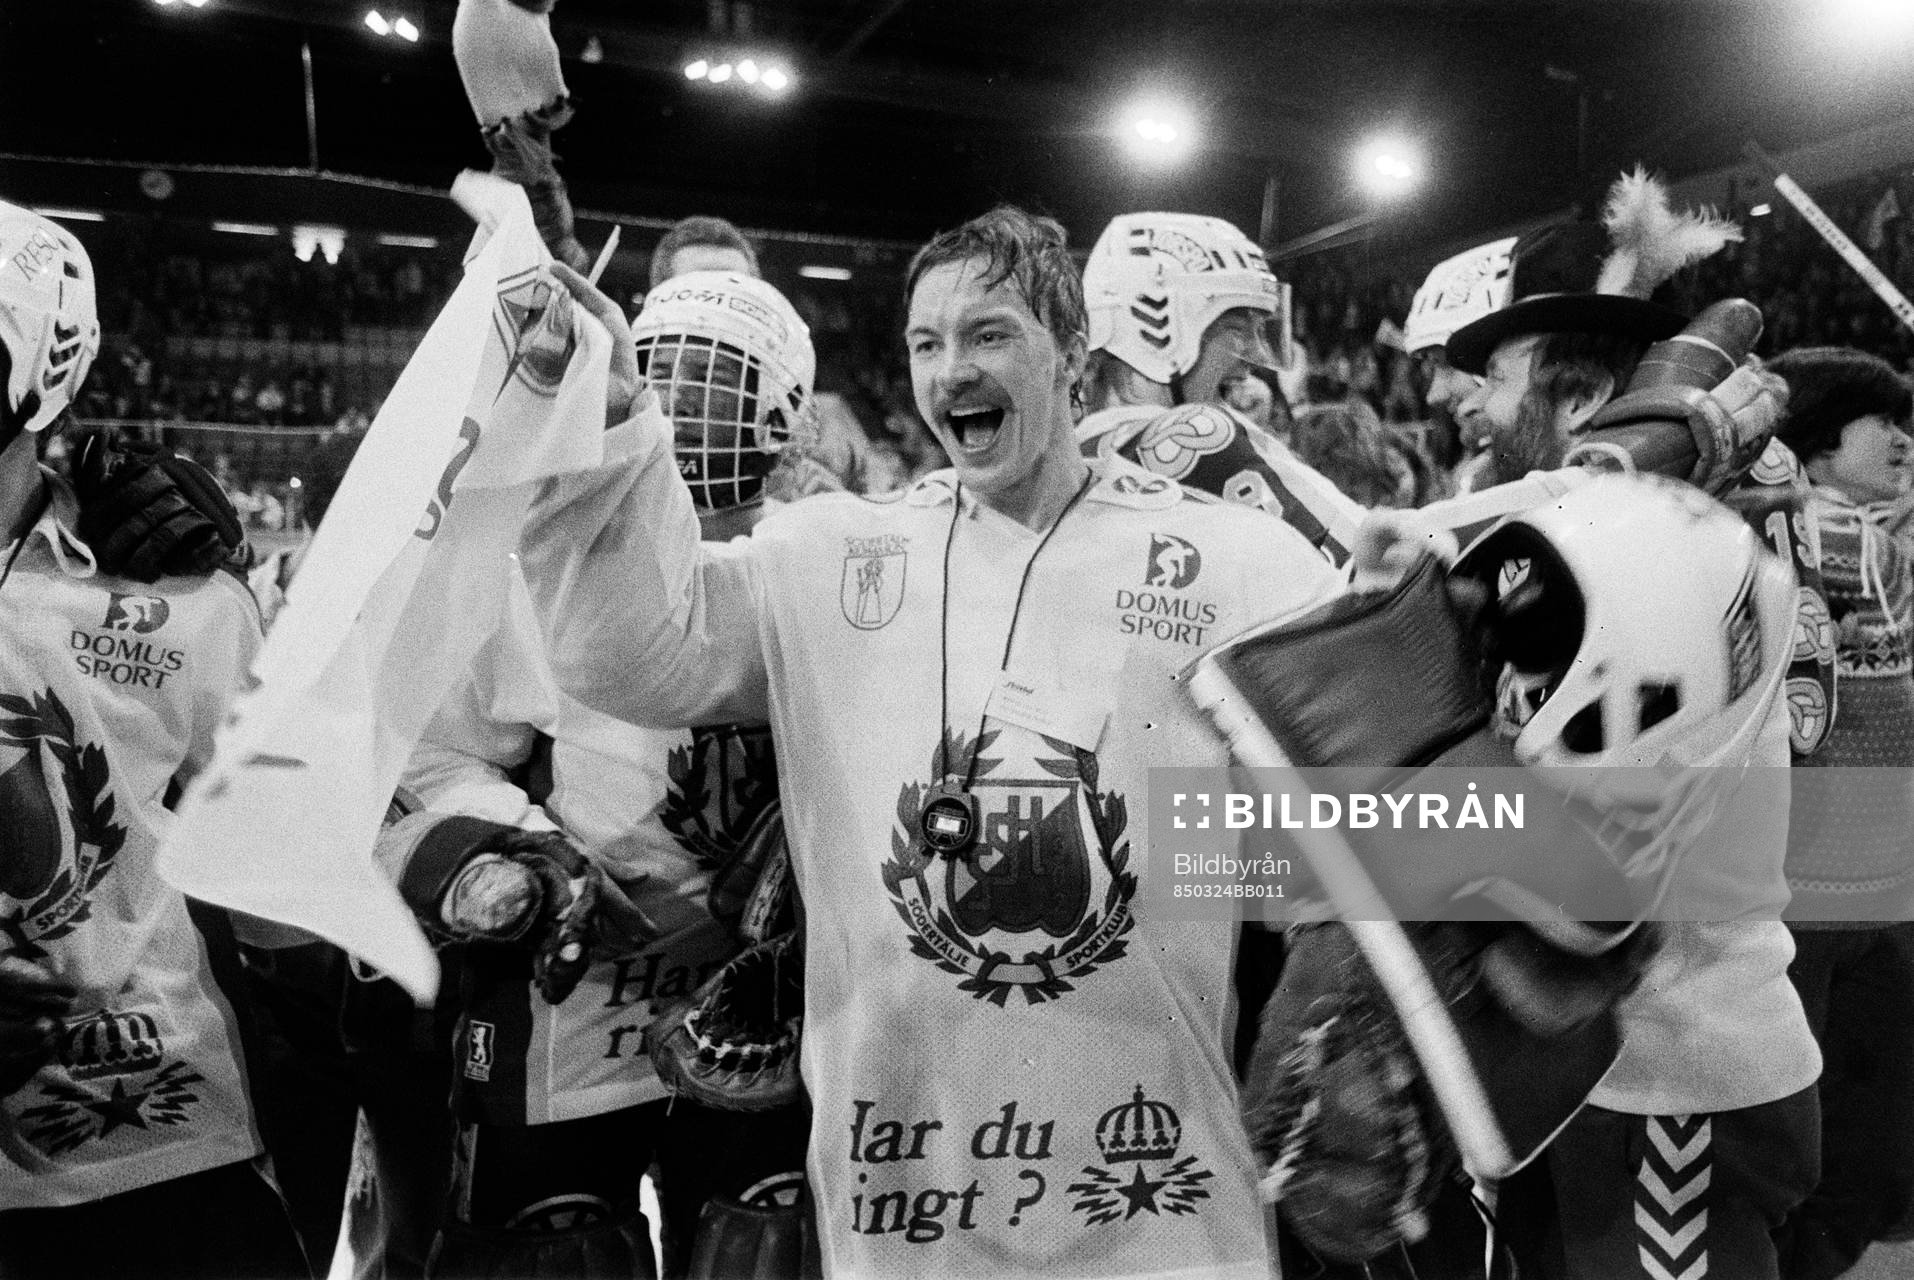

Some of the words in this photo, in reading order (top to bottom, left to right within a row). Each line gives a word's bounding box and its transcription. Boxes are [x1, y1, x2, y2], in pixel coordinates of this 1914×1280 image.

[1116, 589, 1217, 624] DOMUS
[70, 630, 184, 671] DOMUS
[1120, 614, 1209, 646] SPORT
[76, 655, 172, 689] SPORT
[908, 897, 970, 968] SÖDERTÄLJE
[1065, 903, 1127, 969] SPORTKLUB
[971, 1101, 1055, 1160] du
